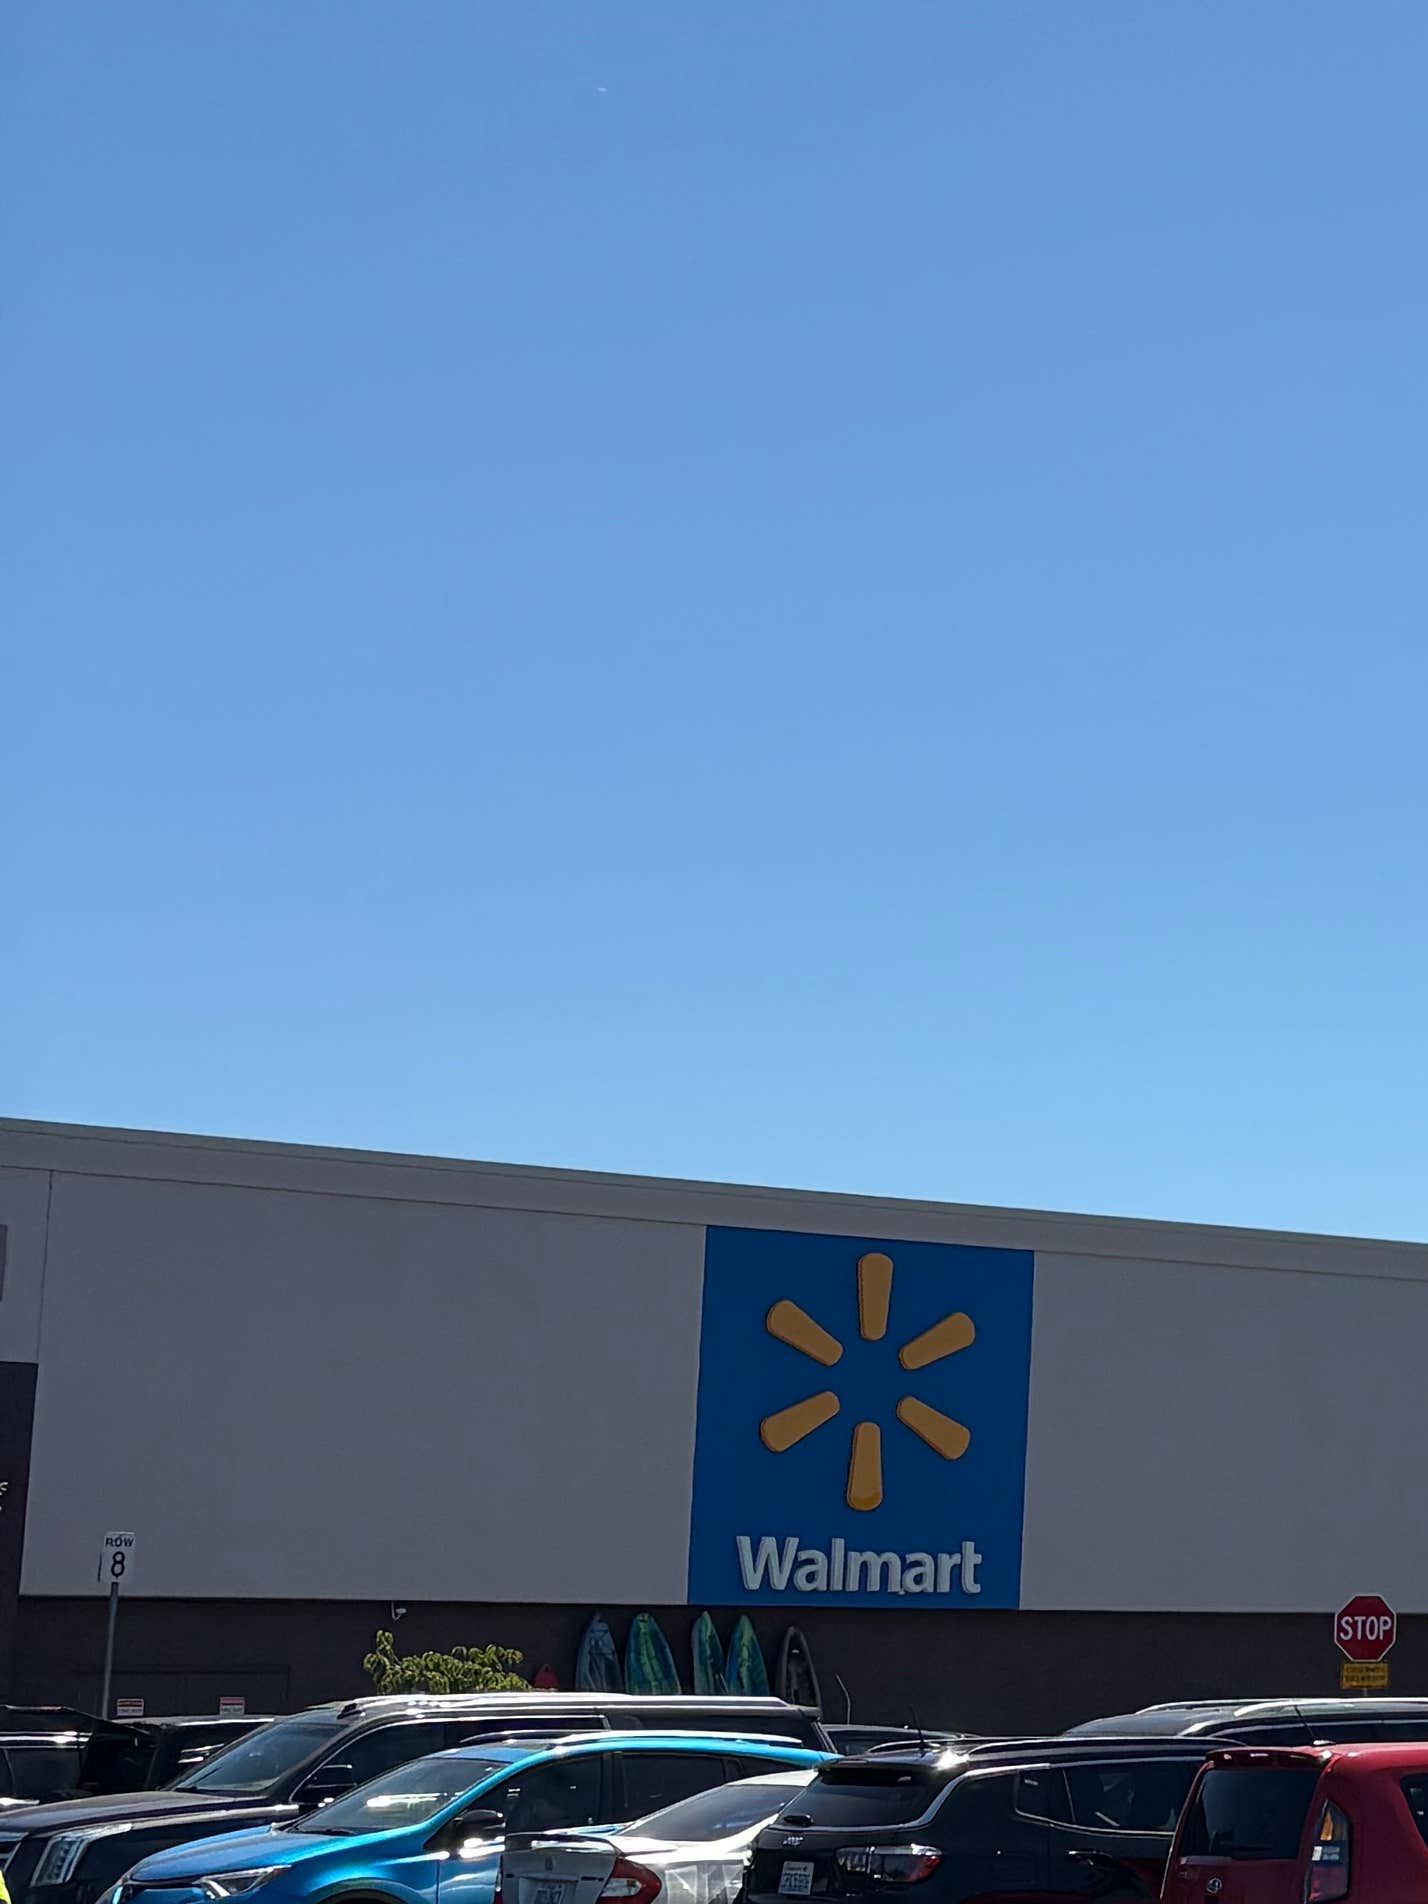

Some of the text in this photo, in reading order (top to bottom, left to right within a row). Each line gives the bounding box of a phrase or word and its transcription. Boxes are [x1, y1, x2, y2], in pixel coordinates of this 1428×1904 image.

[105, 1537, 135, 1547] ROW
[111, 1551, 126, 1577] 8
[736, 1535, 982, 1594] Walmart
[1340, 1616, 1392, 1641] STOP
